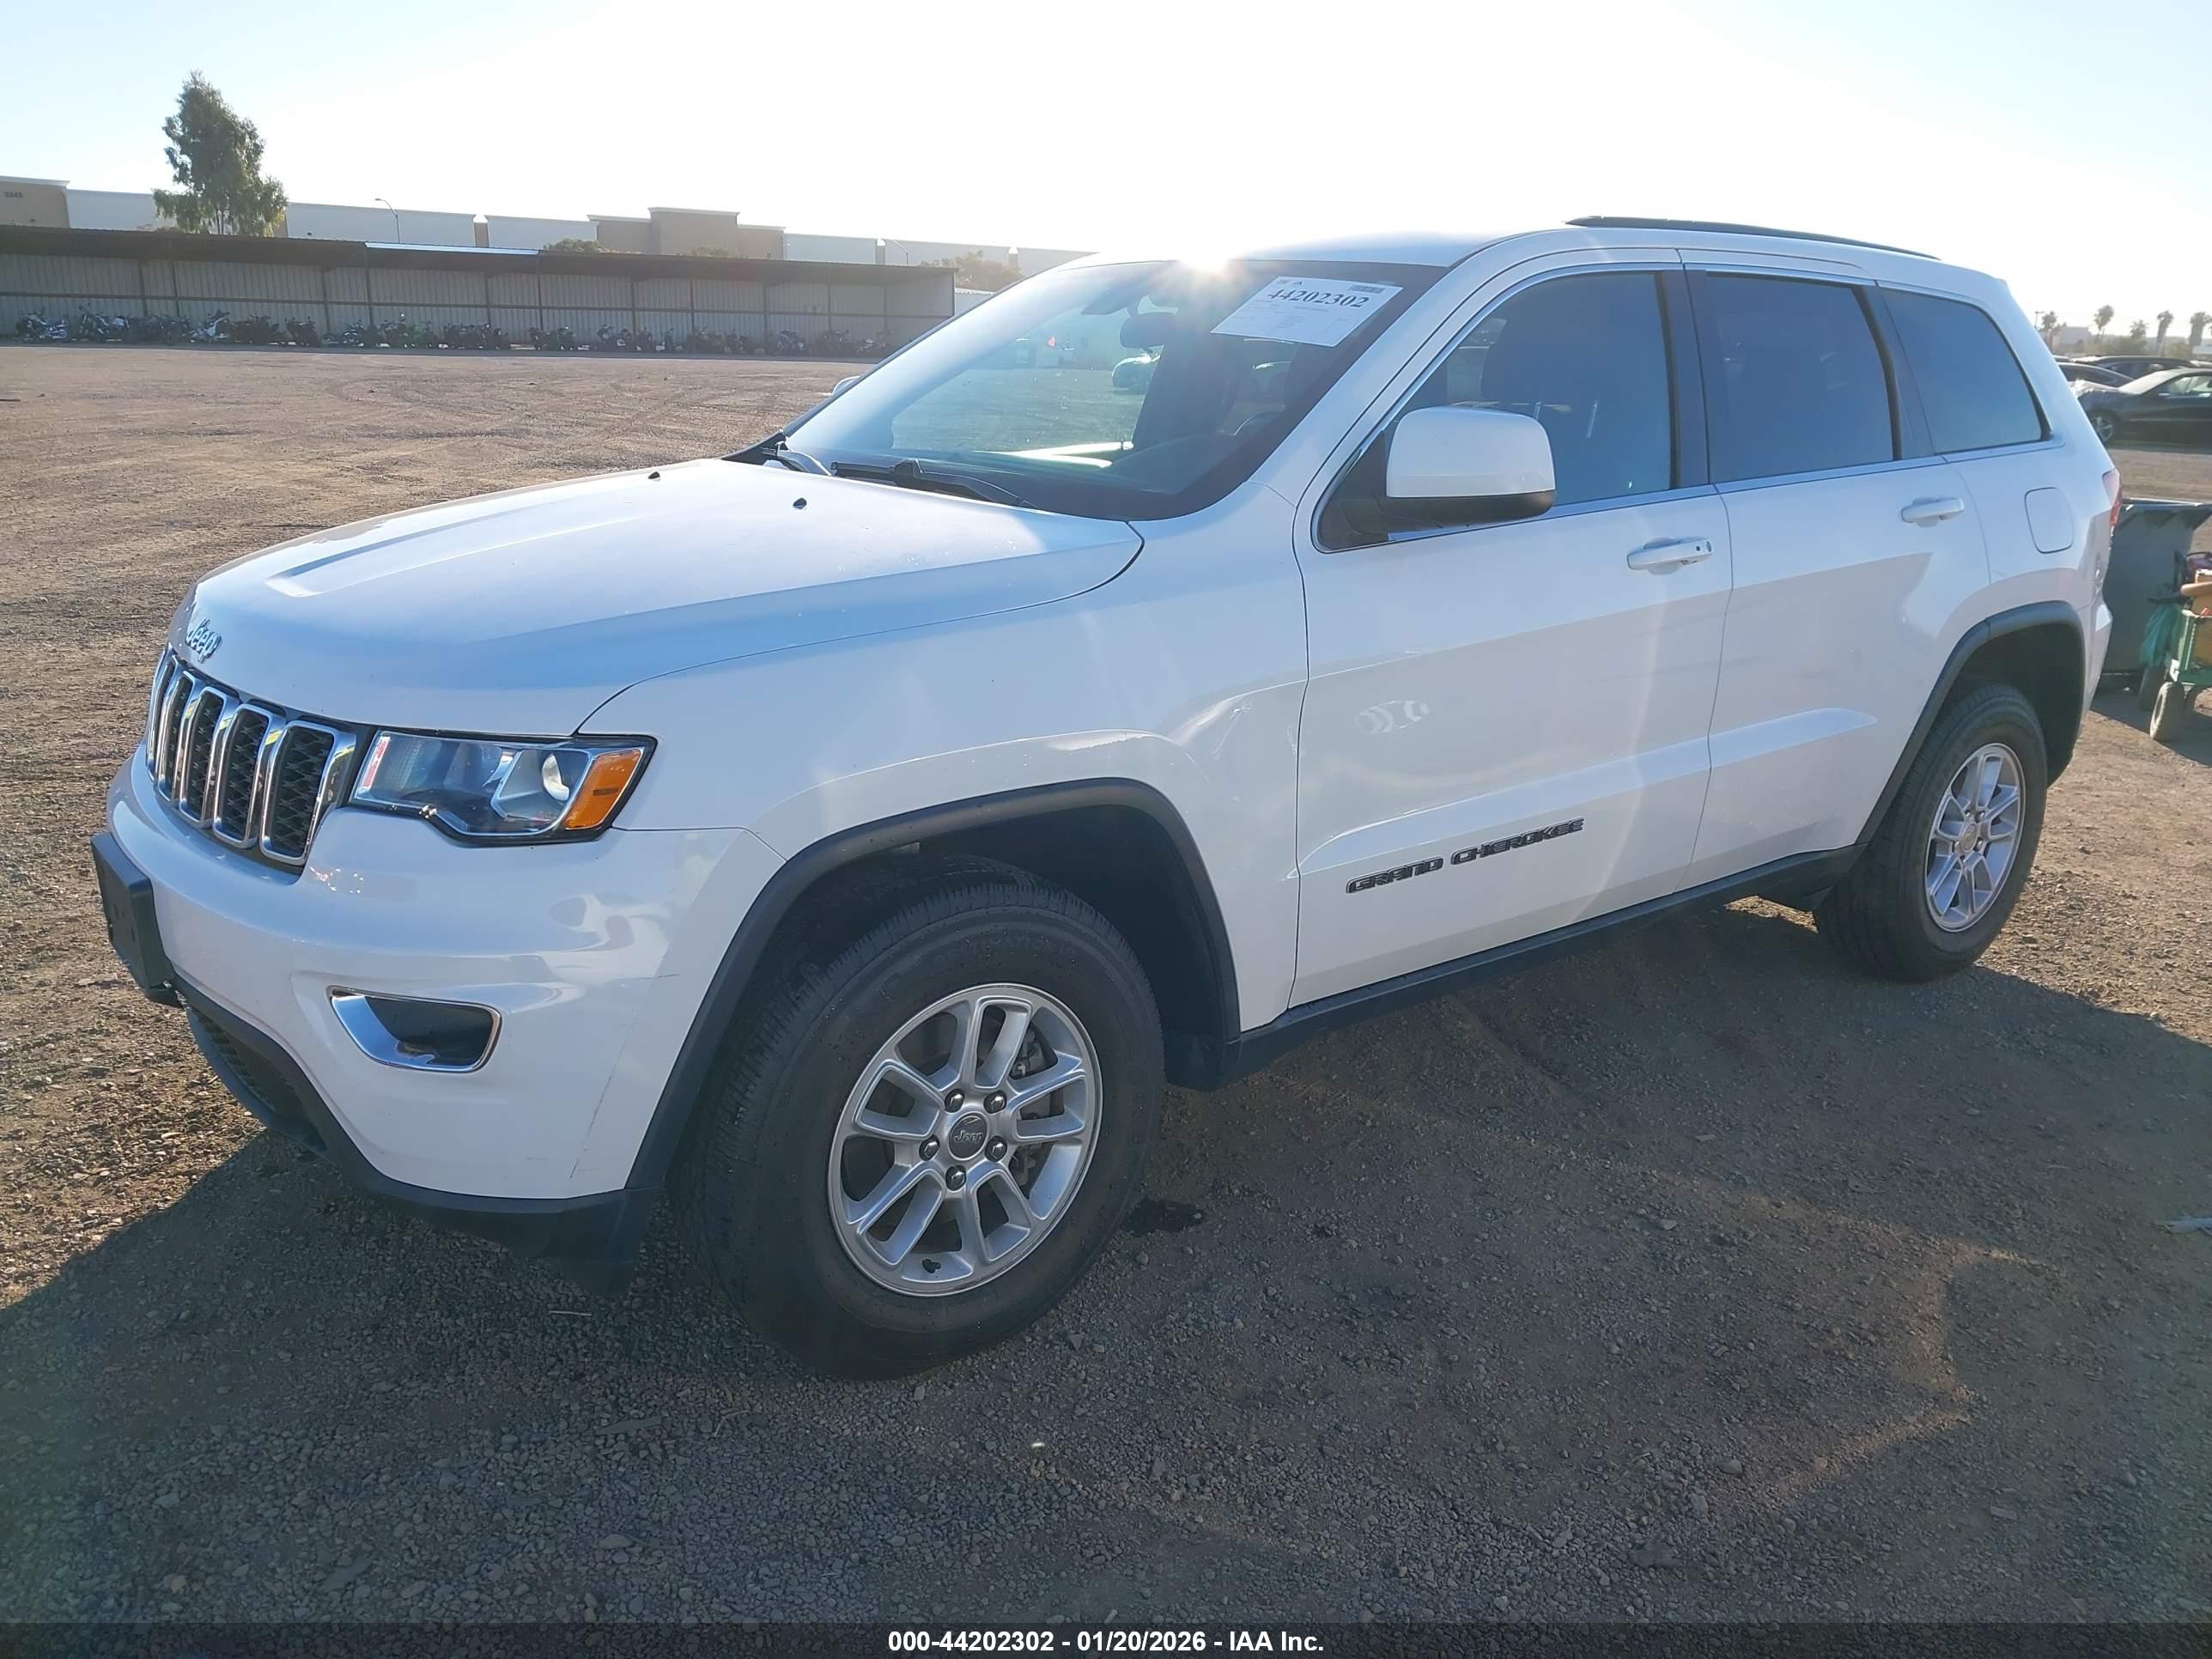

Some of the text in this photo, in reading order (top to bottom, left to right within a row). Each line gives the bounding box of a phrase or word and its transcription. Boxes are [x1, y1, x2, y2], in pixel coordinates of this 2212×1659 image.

[1267, 289, 1370, 308] 44202302
[185, 617, 222, 664] Jeep
[1346, 817, 1584, 893] GRAND CHEROKEE
[954, 1130, 983, 1142] Jeep
